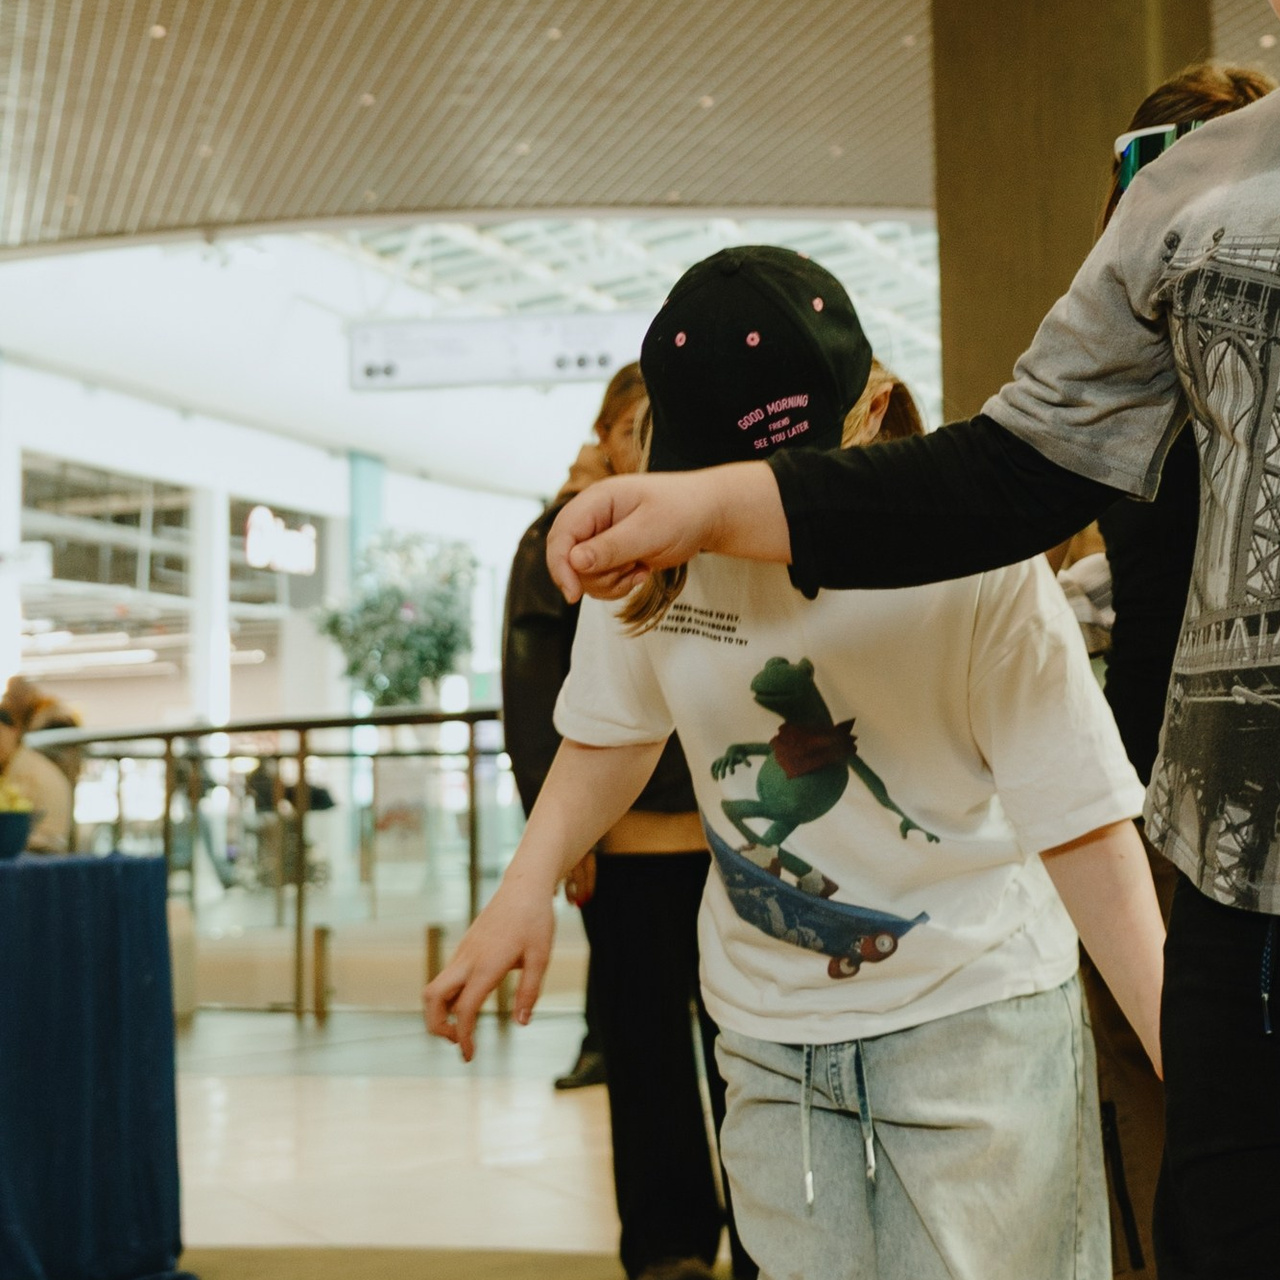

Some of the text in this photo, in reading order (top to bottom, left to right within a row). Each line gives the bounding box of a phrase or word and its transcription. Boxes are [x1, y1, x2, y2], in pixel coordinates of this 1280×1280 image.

[737, 394, 809, 430] GOOD MORNING
[768, 416, 790, 431] FRIEND
[753, 420, 810, 449] SEE YOU LATER
